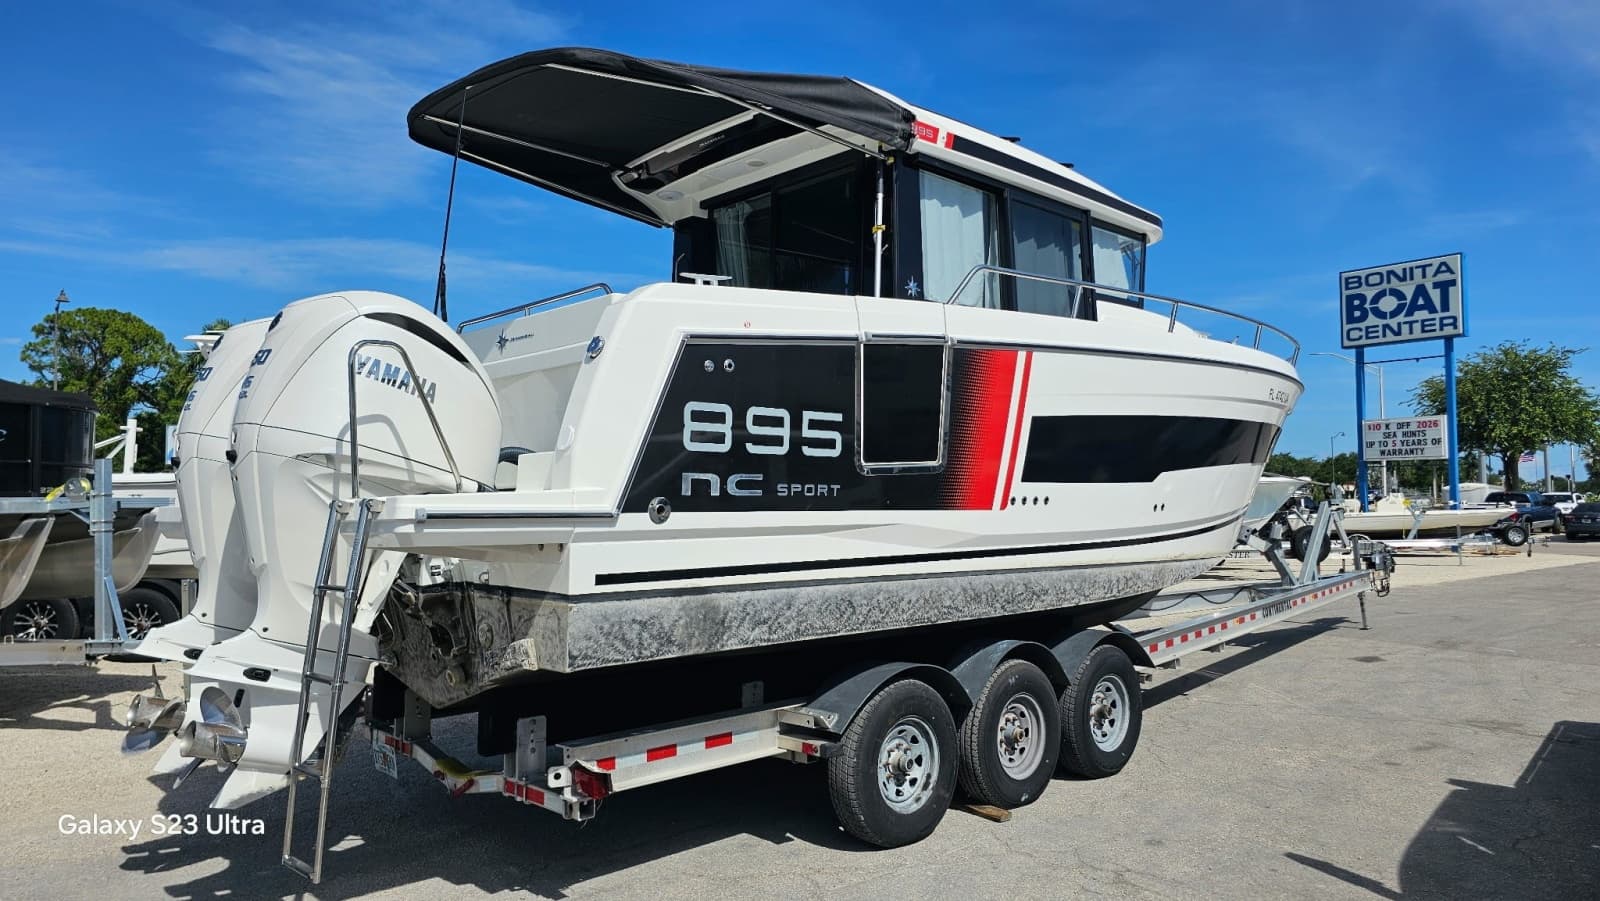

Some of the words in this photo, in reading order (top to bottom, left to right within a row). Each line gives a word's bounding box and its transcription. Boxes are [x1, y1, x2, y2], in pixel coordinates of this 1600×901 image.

[1344, 261, 1456, 291] BONITA
[1345, 279, 1457, 325] BOAT
[1346, 316, 1458, 342] CENTER
[356, 353, 437, 404] YAMAHA
[683, 401, 843, 458] 895
[1397, 421, 1411, 430] OFF
[1416, 420, 1439, 429] 2026
[1378, 440, 1388, 448] TO
[1400, 438, 1427, 447] YEARS
[1431, 438, 1442, 446] OF
[1382, 431, 1398, 440] SEA
[1402, 429, 1426, 438] HUNTS
[1380, 447, 1425, 457] WARRANTY
[776, 484, 841, 497] SPORT
[1262, 600, 1292, 618] CONTINENTAL
